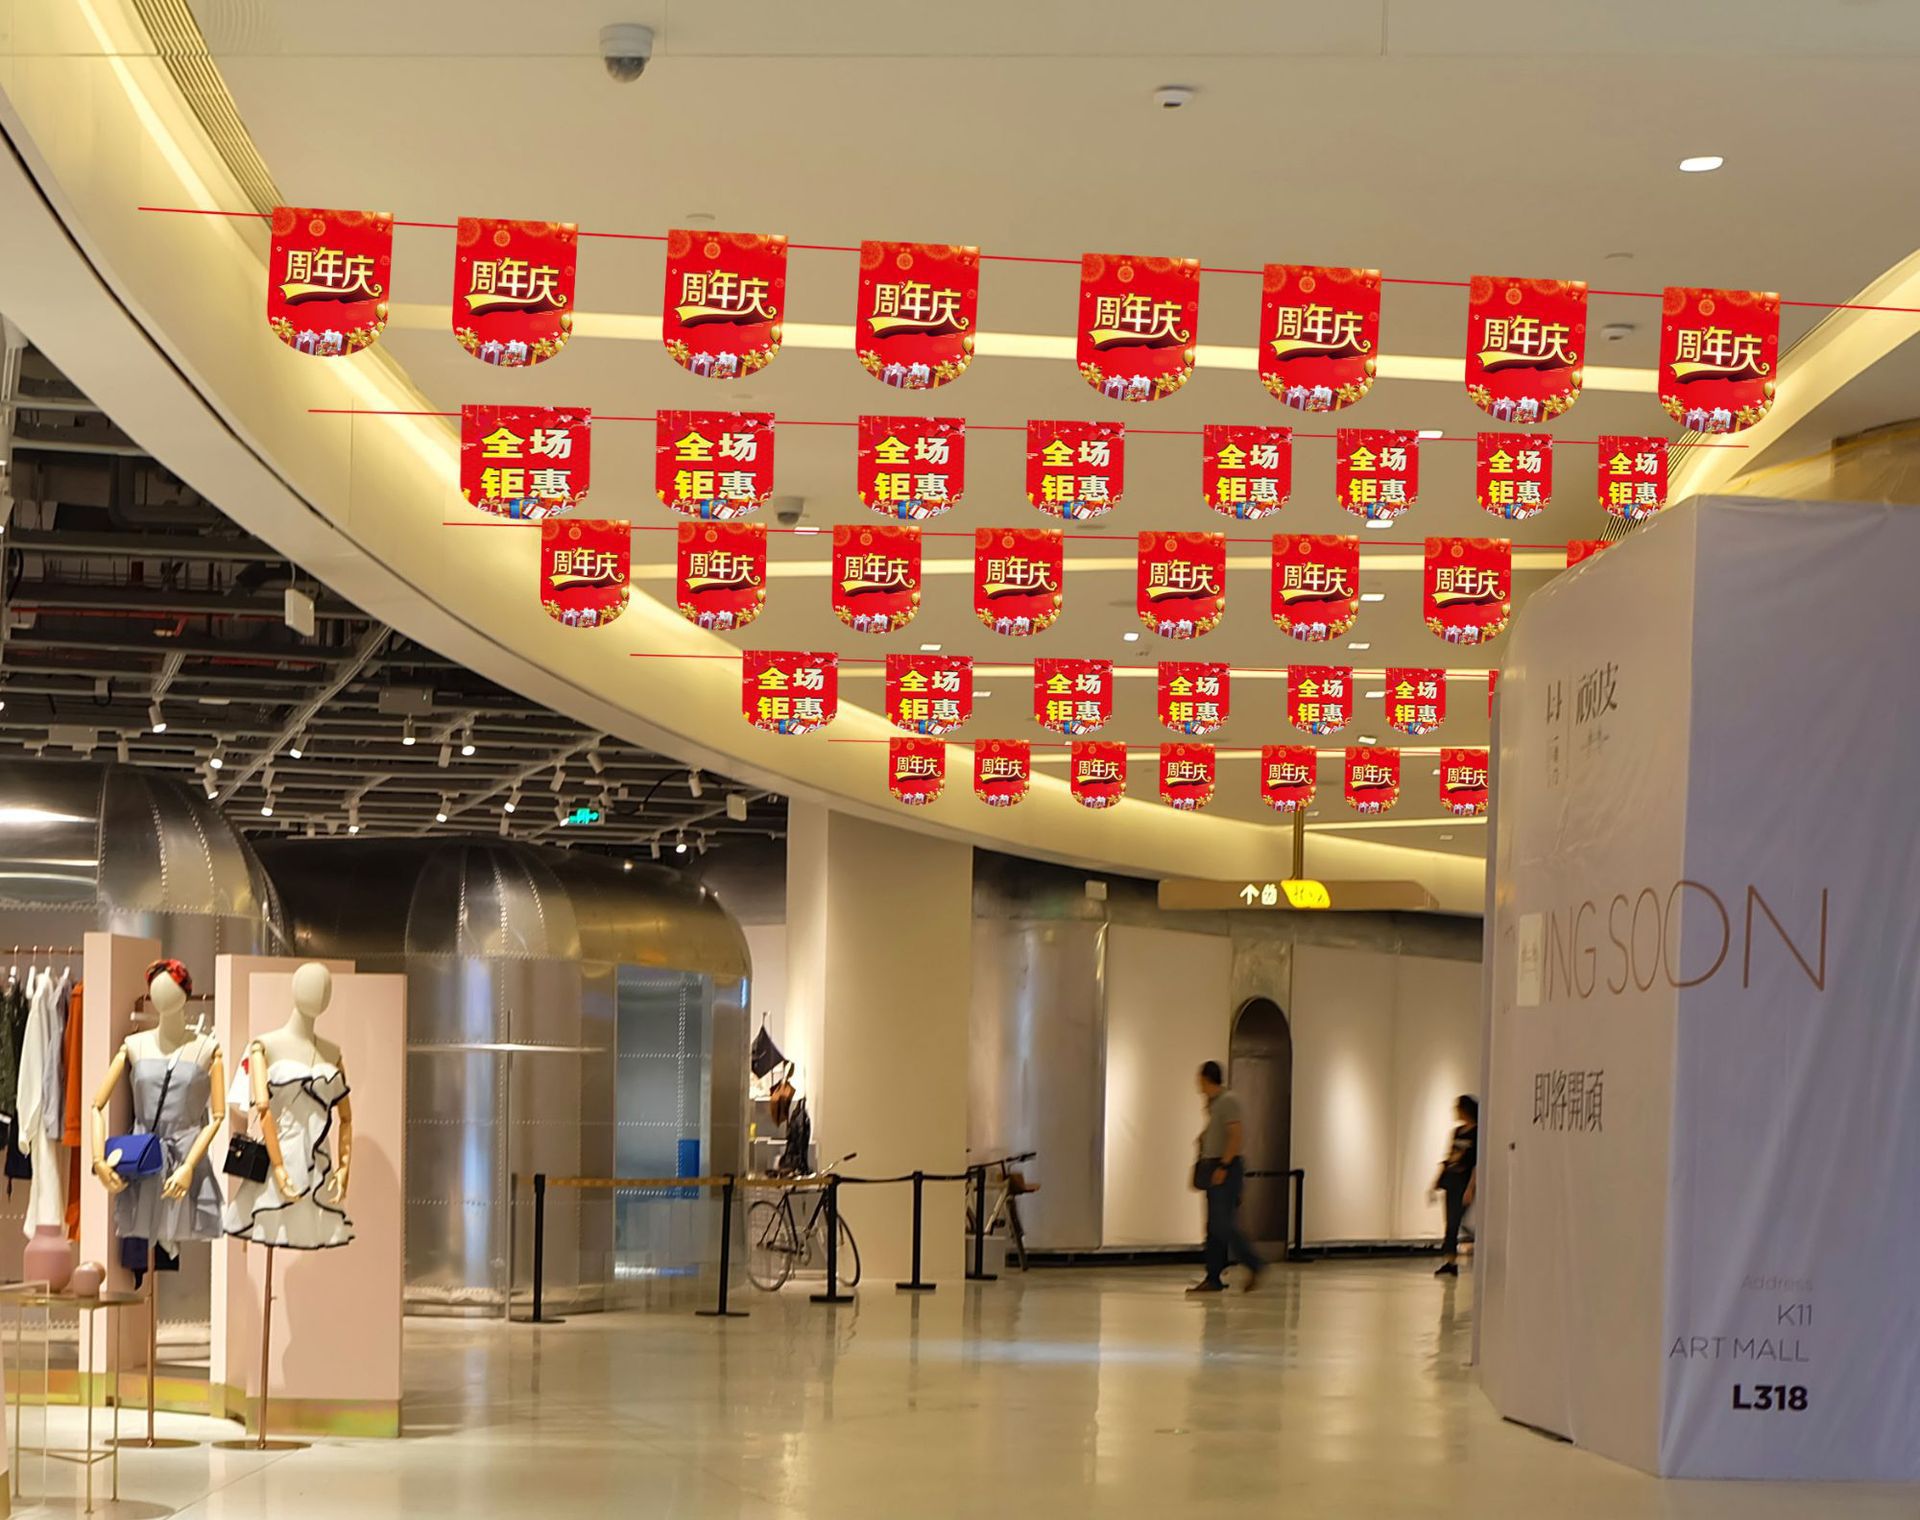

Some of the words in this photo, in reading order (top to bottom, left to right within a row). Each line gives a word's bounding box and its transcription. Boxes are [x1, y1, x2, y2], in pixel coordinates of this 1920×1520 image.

[285, 247, 383, 298] 周年庆
[470, 258, 567, 308] 周年庆
[680, 270, 777, 320] 周年庆
[873, 281, 969, 330] 周年庆
[1094, 293, 1190, 343] 周年庆
[1276, 304, 1371, 353] 周年庆
[1482, 315, 1578, 365] 周年庆
[1675, 326, 1770, 376] 周年庆
[482, 428, 571, 458] 全场
[675, 432, 757, 461] 全场
[875, 437, 949, 464] 全场
[1042, 440, 1110, 466] 全场
[1218, 444, 1278, 469] 全场
[1350, 447, 1406, 471] 全场
[1489, 450, 1541, 473] 全场
[1610, 452, 1657, 475] 全场
[481, 468, 571, 498] 钜惠
[673, 470, 757, 499] 钜惠
[873, 473, 949, 501] 钜惠
[1042, 475, 1110, 501] 钜惠
[1217, 477, 1278, 501] 钜惠
[1349, 479, 1406, 502] 钜惠
[1489, 480, 1541, 504] 钜惠
[1609, 482, 1657, 503] 钜惠
[554, 548, 624, 585] 周年庆
[690, 550, 760, 587] 周年庆
[845, 553, 915, 590] 周年庆
[987, 556, 1057, 593] 周年庆
[1150, 560, 1219, 596] 周年庆
[1284, 562, 1353, 599] 周年庆
[1436, 565, 1505, 602] 周年庆
[758, 667, 824, 690] 全场
[900, 670, 960, 692] 全场
[1047, 674, 1101, 694] 全场
[1170, 676, 1219, 696] 全场
[1298, 679, 1343, 697] 全场
[1396, 681, 1437, 699] 全场
[757, 697, 824, 719] 钜惠
[899, 699, 960, 719] 钜惠
[1046, 700, 1101, 720] 钜惠
[1169, 702, 1219, 721] 钜惠
[1298, 703, 1343, 718] 钜惠
[1395, 704, 1437, 719] 钜惠
[897, 755, 942, 778] 周年庆
[983, 757, 1027, 780] 周年庆
[1079, 759, 1123, 782] 周年庆
[1168, 761, 1212, 784] 周年庆
[1269, 763, 1313, 786] 周年庆
[1353, 764, 1397, 788] 周年庆
[1607, 880, 1828, 993] SOON
[1777, 1303, 1813, 1327] K11
[1669, 1336, 1727, 1360] ART
[1733, 1337, 1810, 1363] MALL
[1732, 1383, 1809, 1412] L318
